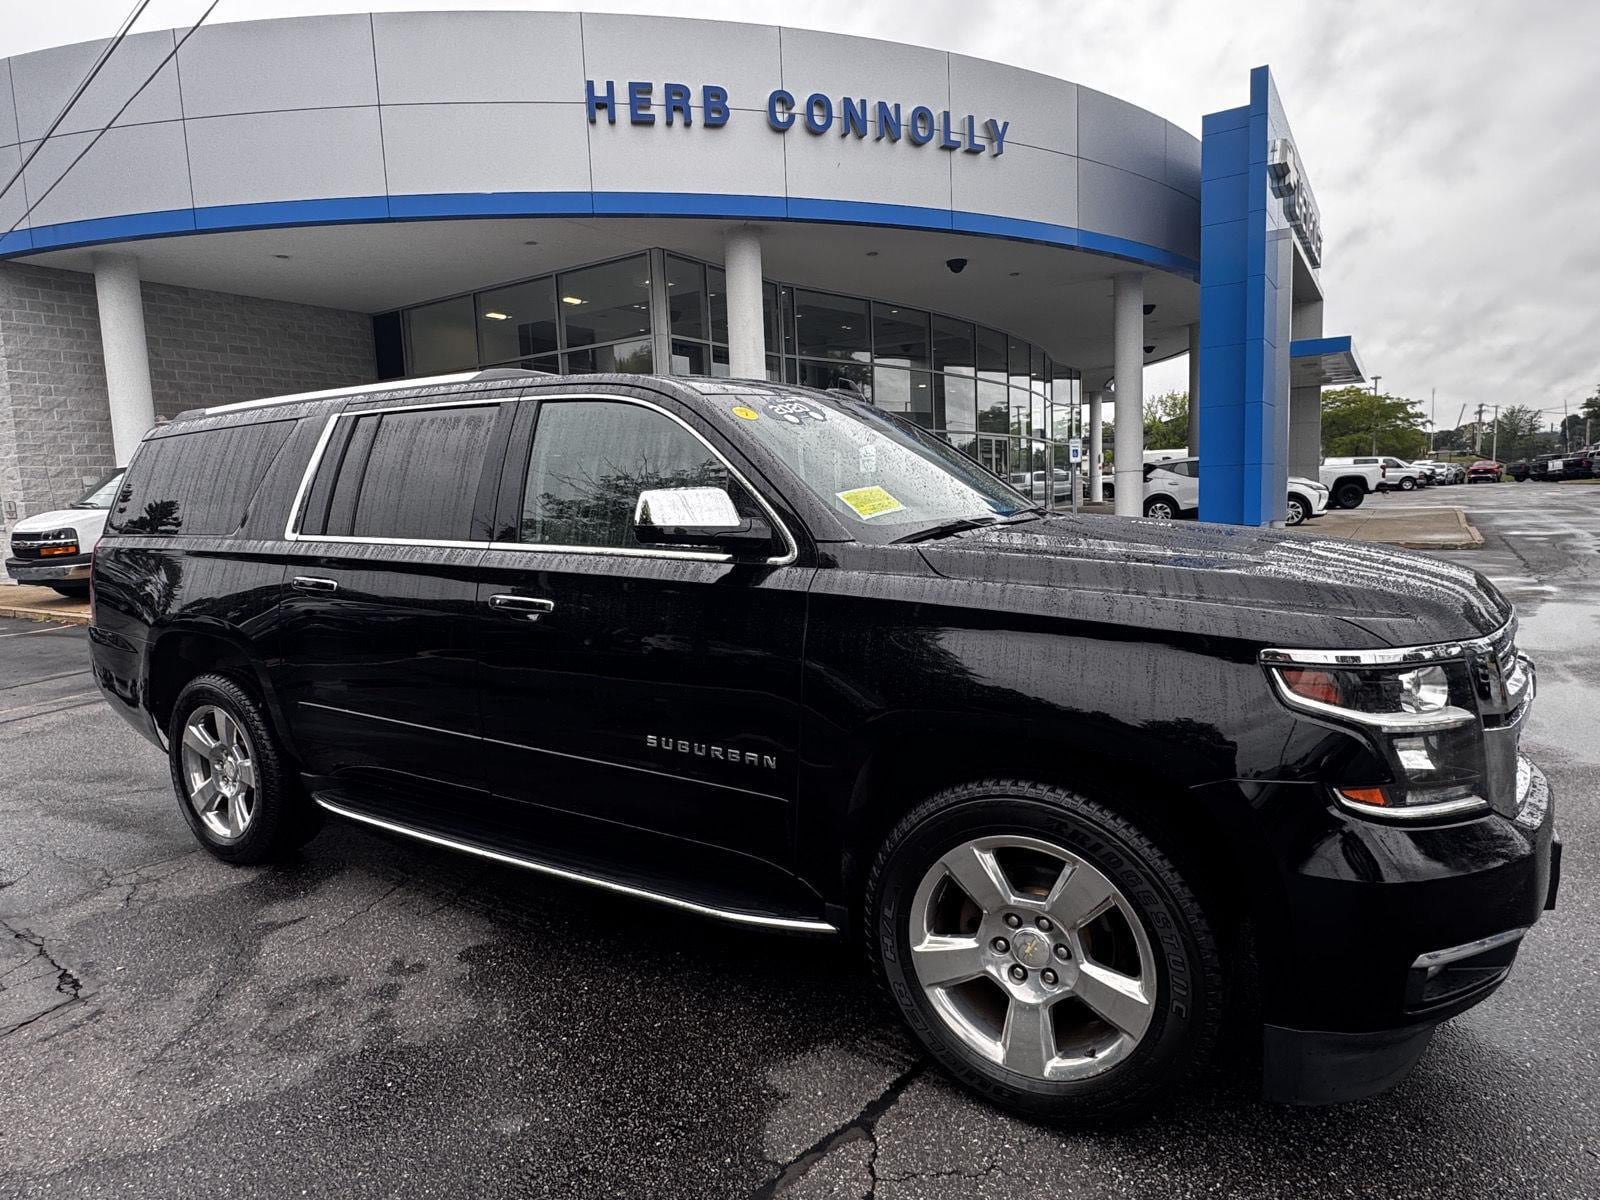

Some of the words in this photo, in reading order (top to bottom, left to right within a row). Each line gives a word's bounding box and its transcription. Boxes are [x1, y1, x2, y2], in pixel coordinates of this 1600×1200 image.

[586, 80, 730, 128] HERB
[767, 89, 1009, 157] CONNOLLY
[646, 735, 776, 769] SUBURBAN
